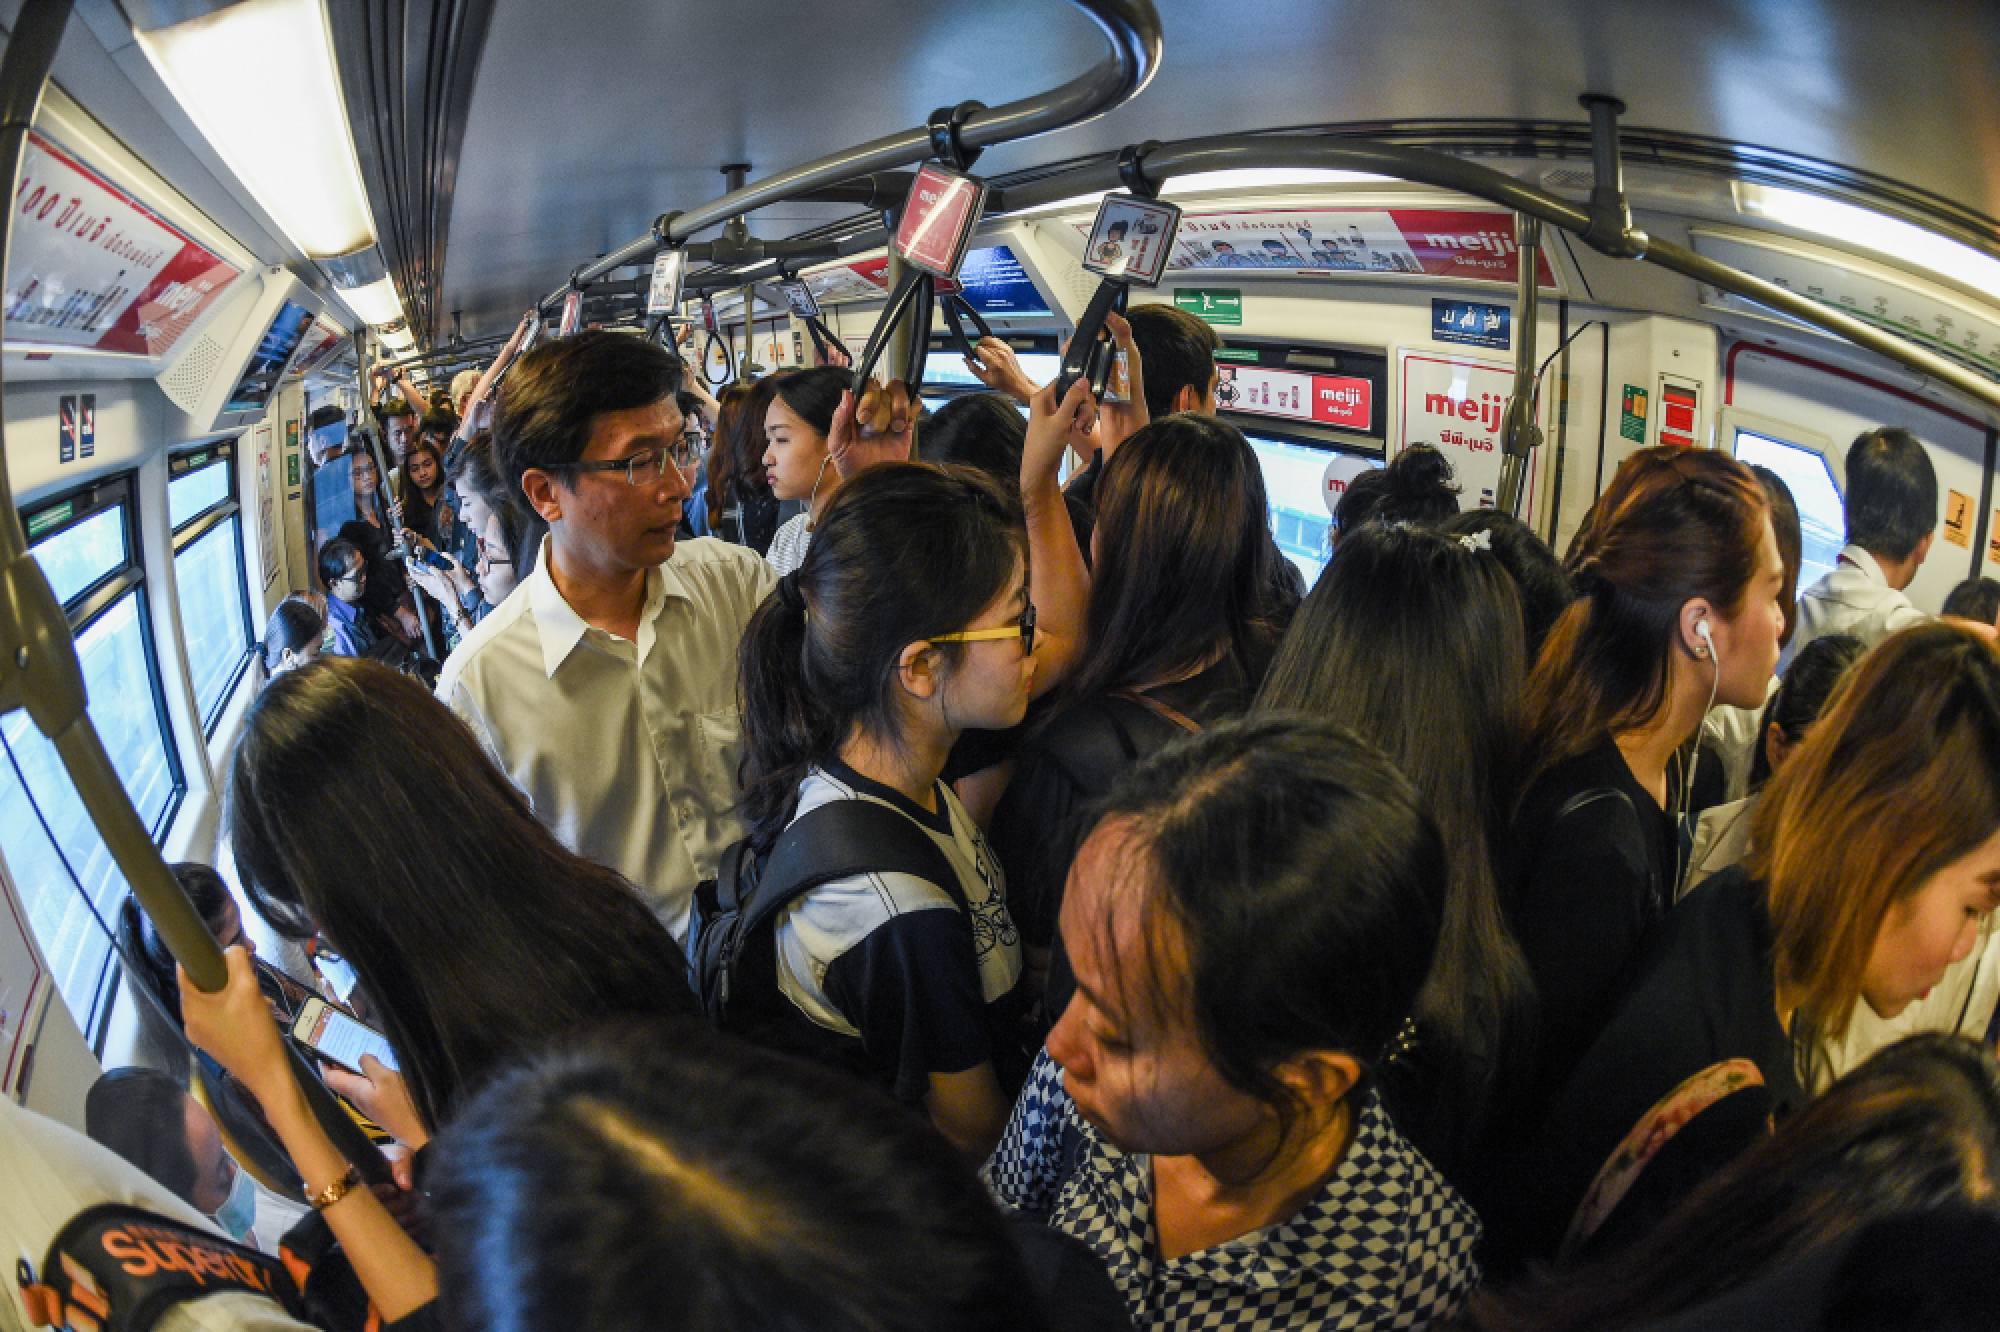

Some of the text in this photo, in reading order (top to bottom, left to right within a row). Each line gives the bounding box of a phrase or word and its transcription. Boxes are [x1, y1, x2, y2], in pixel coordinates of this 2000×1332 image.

[1423, 230, 1517, 257] meiji
[1319, 387, 1362, 407] meiji
[1425, 391, 1510, 435] meij
